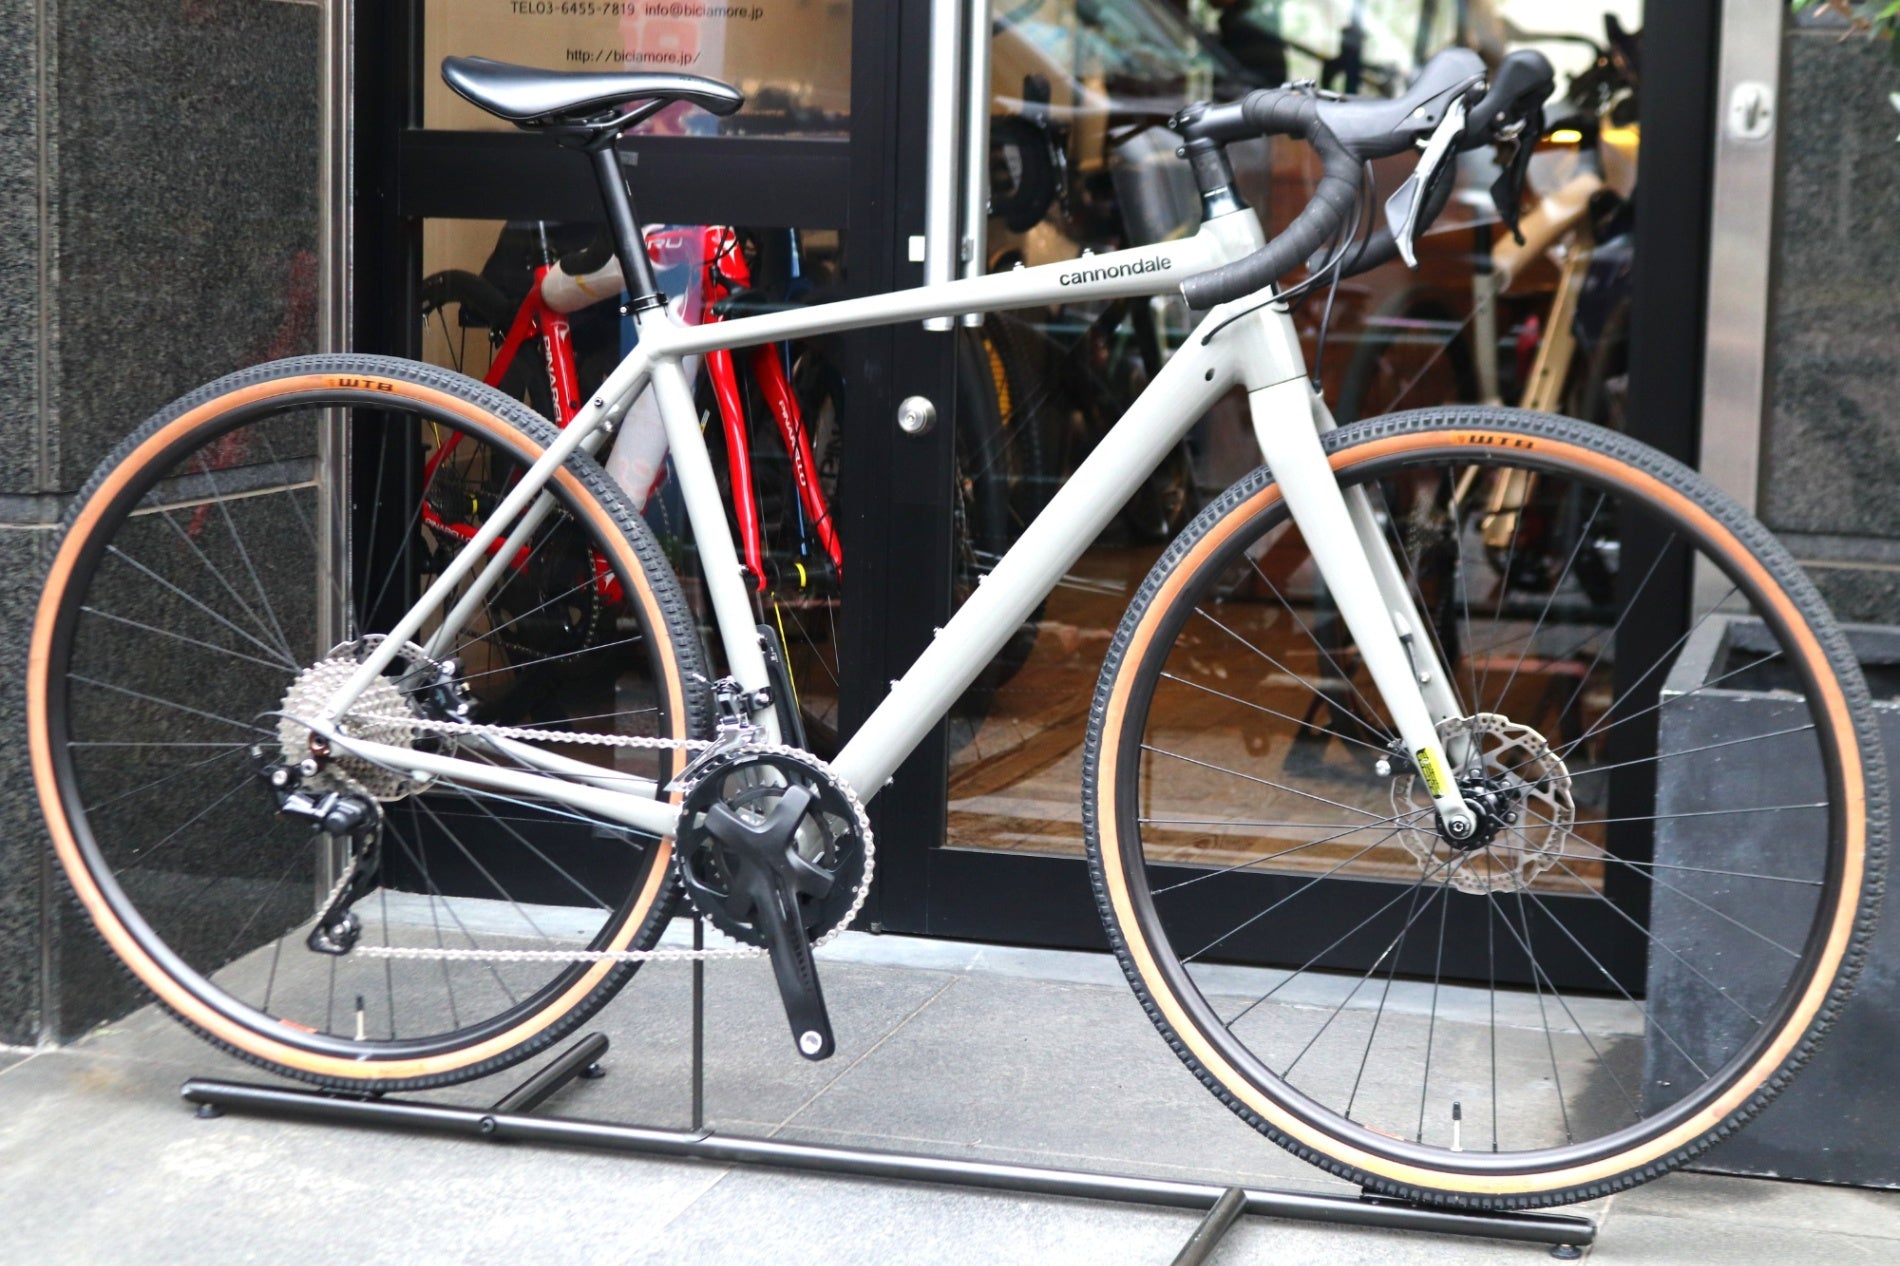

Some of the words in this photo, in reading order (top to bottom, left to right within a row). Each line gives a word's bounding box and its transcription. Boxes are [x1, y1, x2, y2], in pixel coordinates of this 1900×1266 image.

[511, 1, 636, 17] TEL03-6455-7819
[645, 3, 764, 21] info@biciamore.jp
[566, 48, 701, 65] http://biciamore.jp/
[1059, 255, 1172, 286] cannondale
[338, 378, 394, 392] WTB
